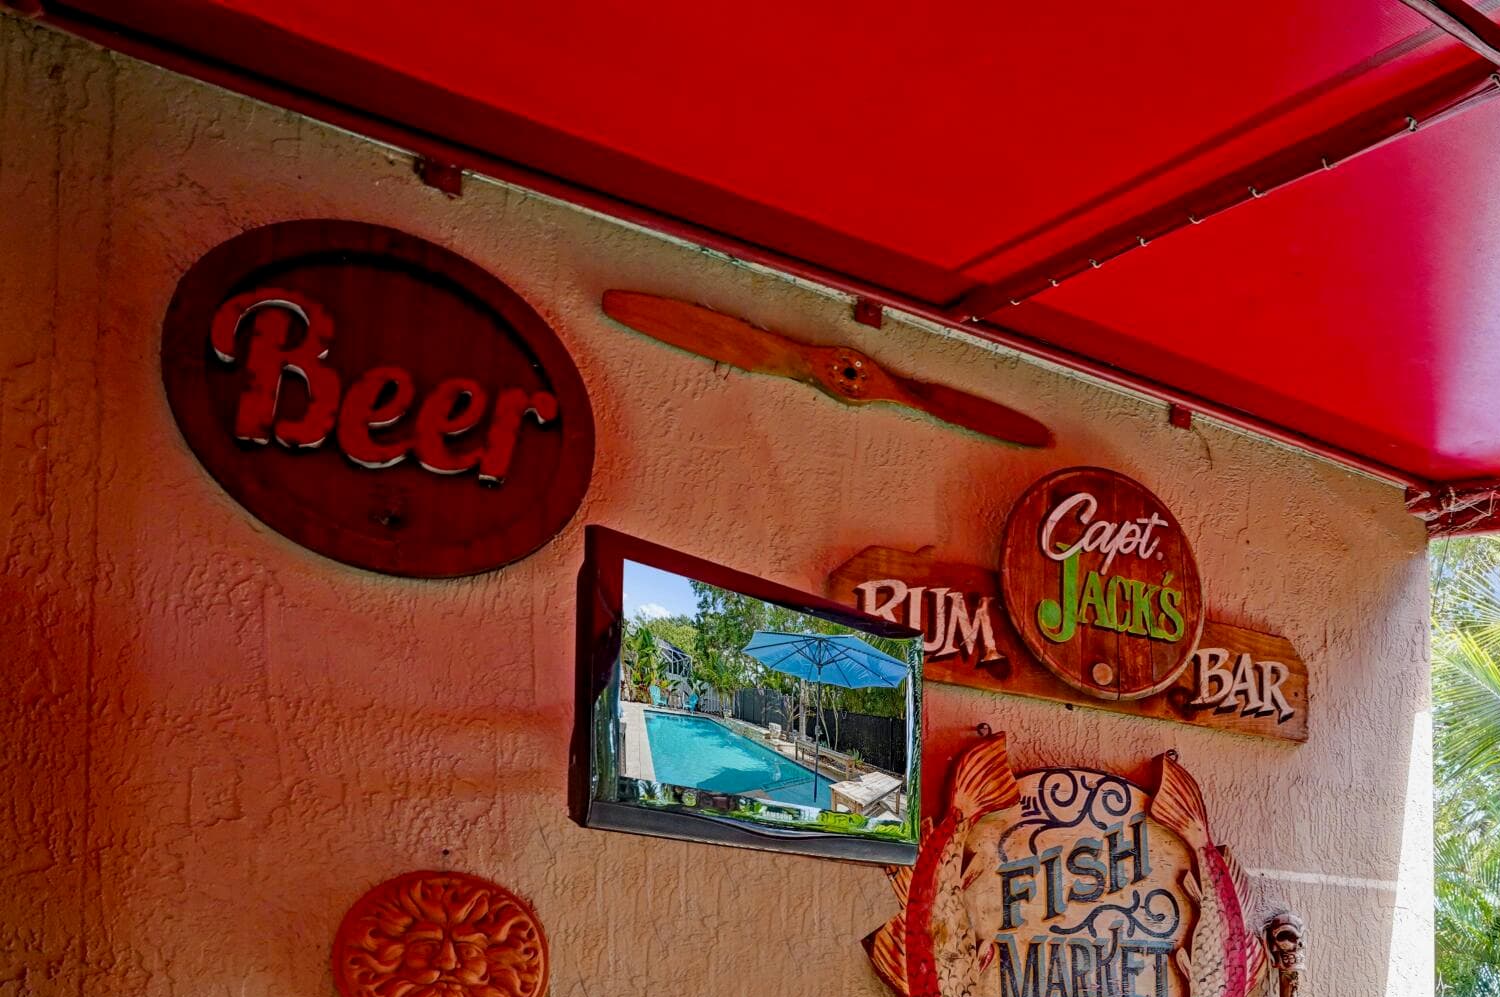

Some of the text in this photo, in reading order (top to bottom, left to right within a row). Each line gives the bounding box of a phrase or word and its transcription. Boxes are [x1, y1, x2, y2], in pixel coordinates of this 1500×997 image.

[211, 289, 558, 485] Beer
[1041, 492, 1168, 574] Capt.
[856, 579, 1295, 723] RUM BAR
[997, 813, 1152, 931] FISH
